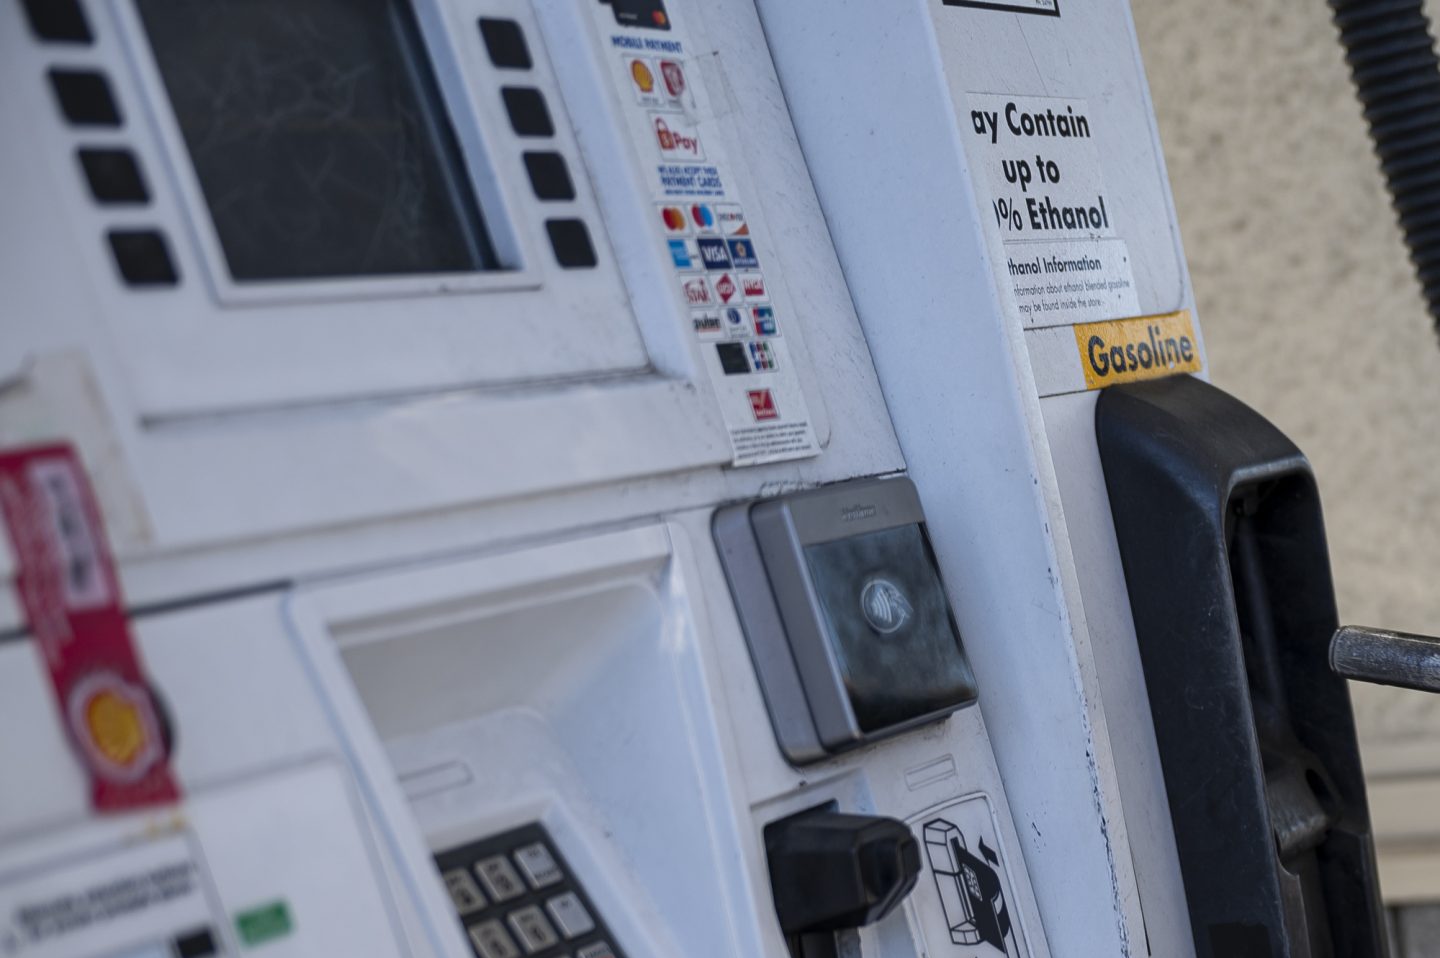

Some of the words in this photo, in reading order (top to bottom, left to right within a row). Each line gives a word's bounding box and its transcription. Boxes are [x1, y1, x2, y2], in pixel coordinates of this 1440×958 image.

[1004, 102, 1090, 138] Contain
[1002, 160, 1032, 192] up
[1036, 155, 1060, 184] to
[1025, 195, 1109, 230] Ethanol
[703, 246, 729, 262] VISA
[1043, 255, 1102, 274] Information
[1046, 282, 1062, 294] about
[1063, 282, 1084, 294] ethanol
[1085, 279, 1108, 292] blended
[1108, 279, 1130, 293] gasoline
[1019, 304, 1033, 316] may
[1033, 301, 1042, 312] be
[1042, 300, 1060, 312] found
[1061, 298, 1077, 310] inside
[1077, 298, 1087, 308] the
[1088, 326, 1194, 377] Gasoline
